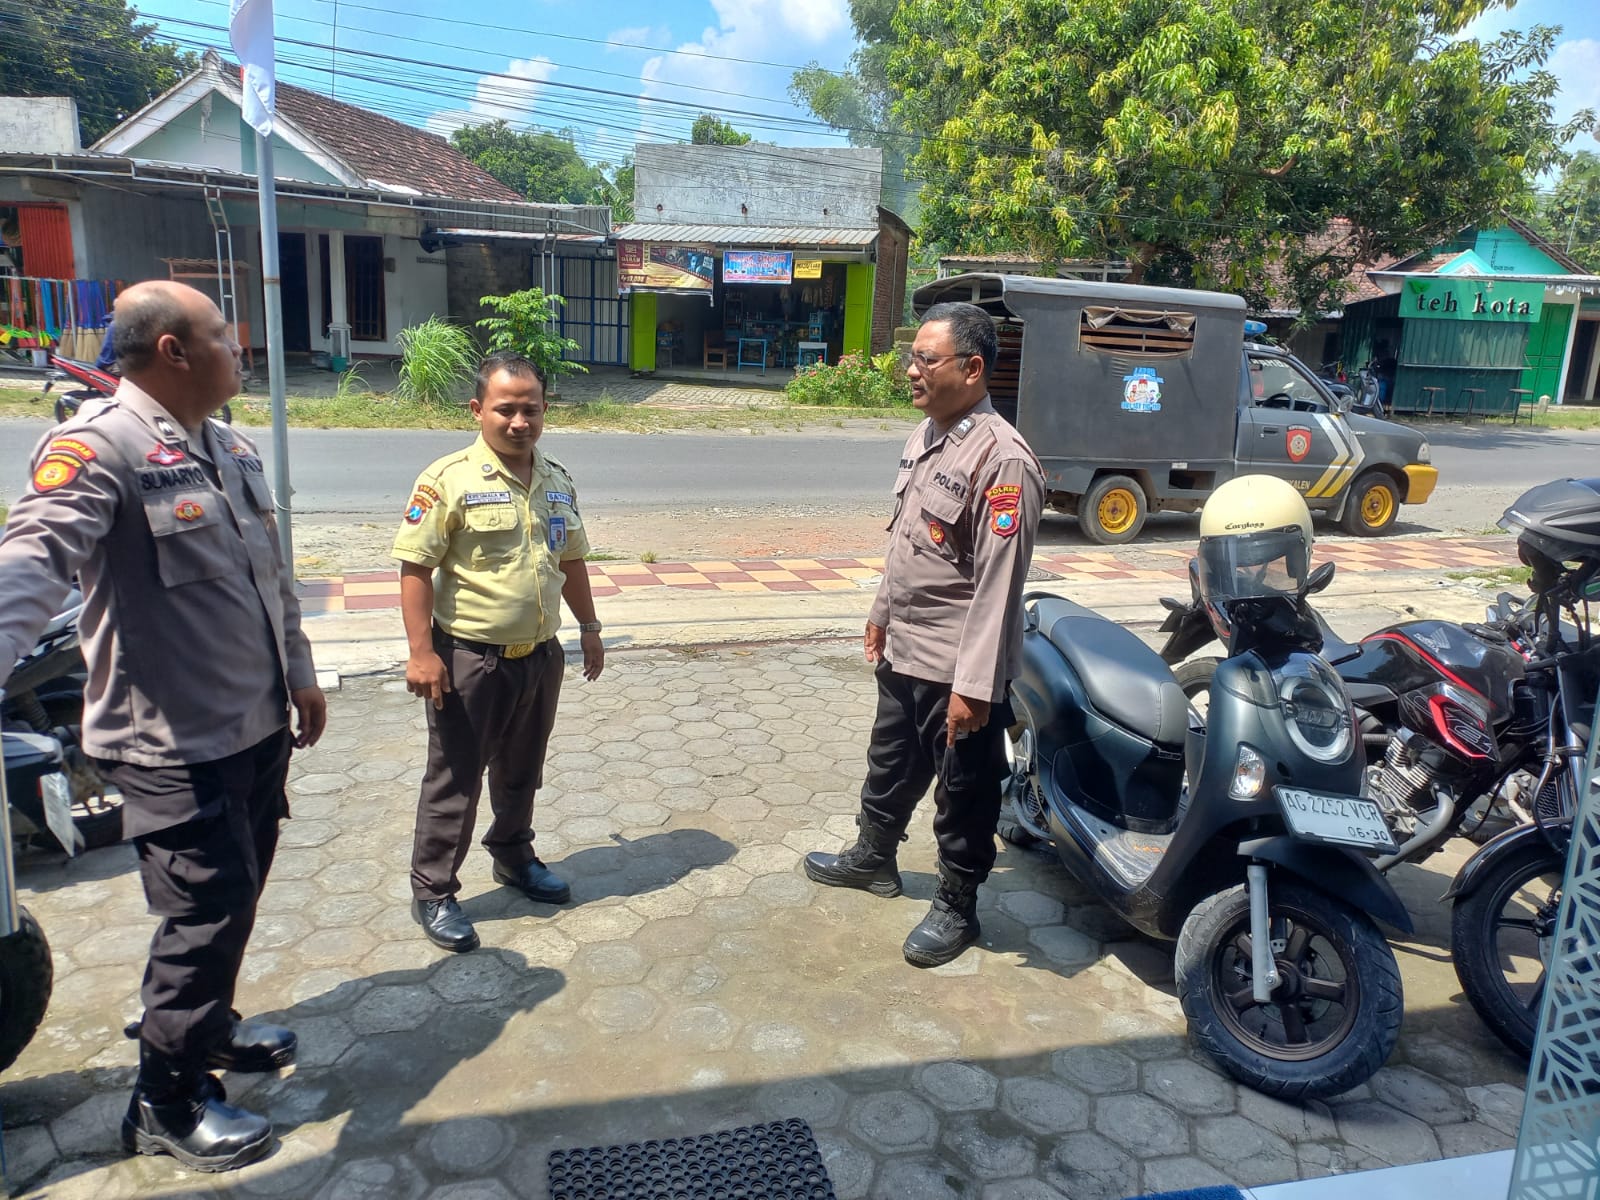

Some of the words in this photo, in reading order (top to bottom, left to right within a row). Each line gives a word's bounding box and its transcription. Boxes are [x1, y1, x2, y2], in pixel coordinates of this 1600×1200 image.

[1417, 291, 1458, 313] teh
[1472, 292, 1532, 315] kota
[140, 467, 205, 491] SUNARYO
[933, 471, 967, 499] POLRI
[1285, 792, 1307, 812] AG
[1307, 796, 1349, 818] 2252
[1348, 800, 1380, 822] VCR
